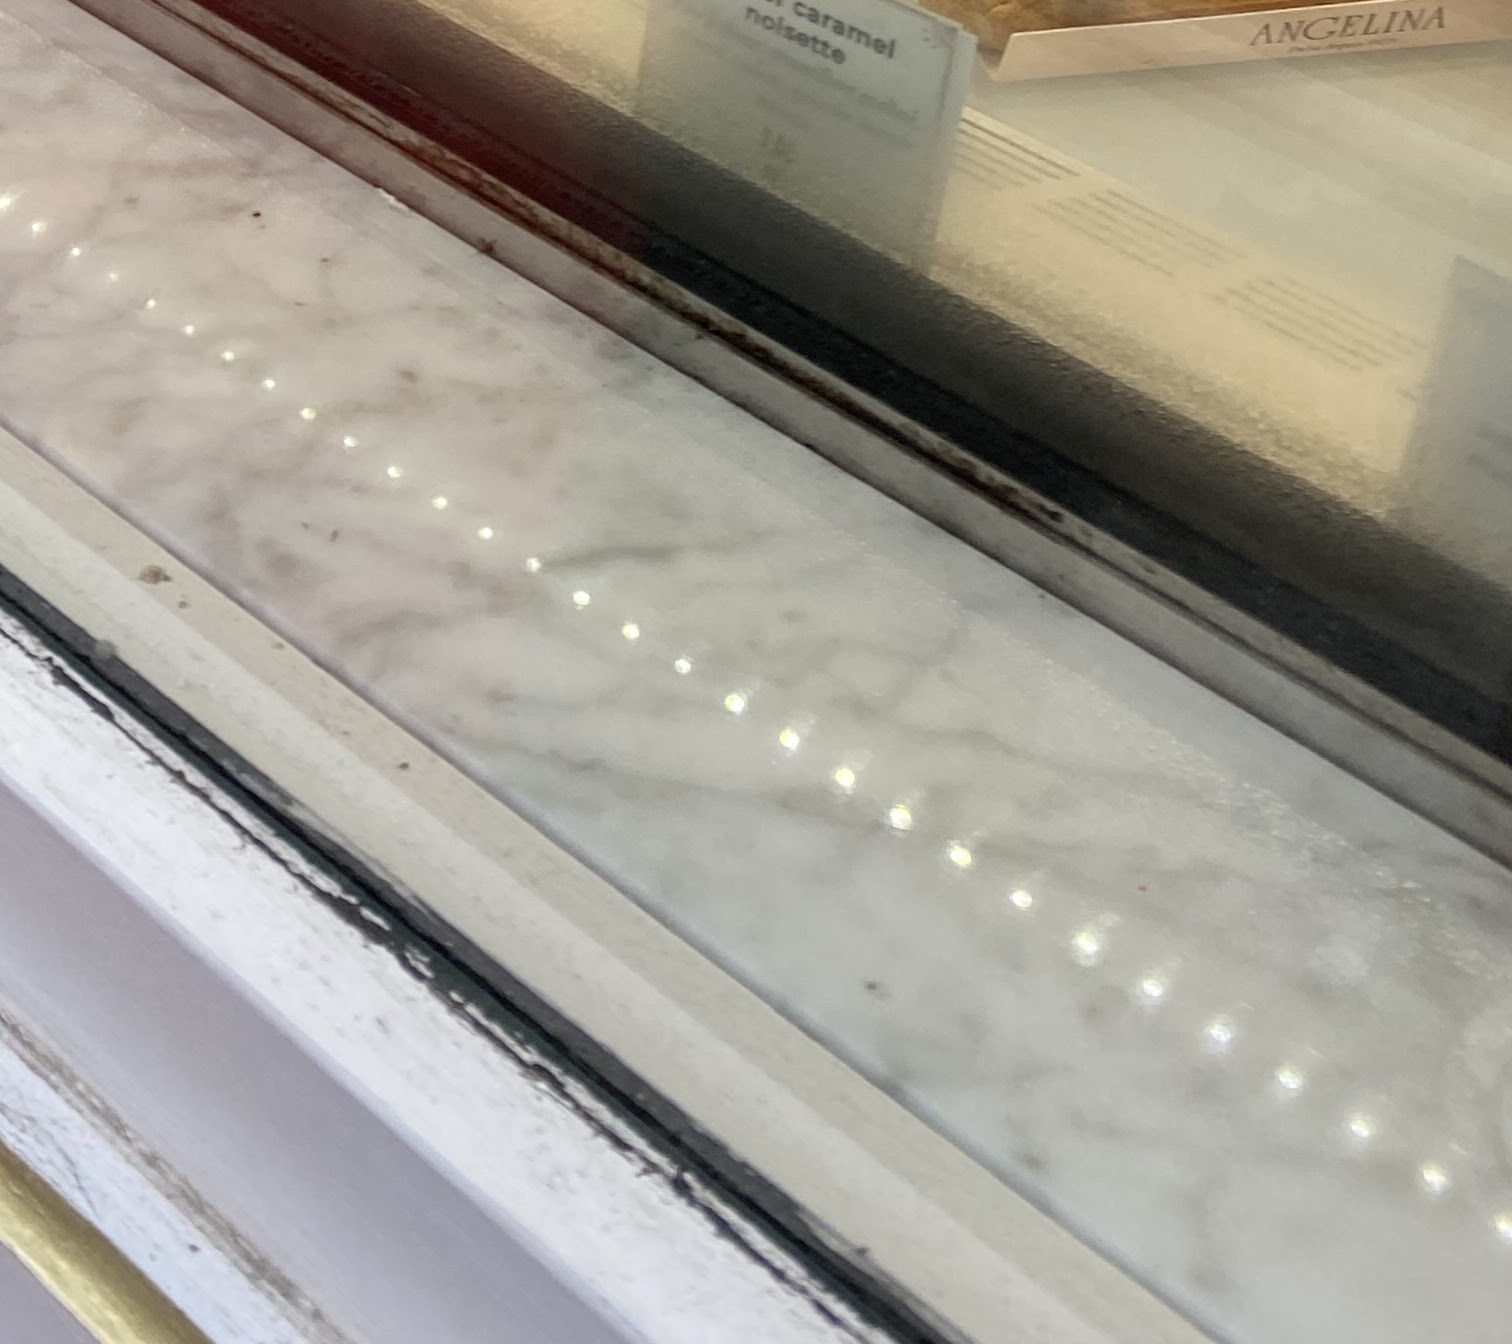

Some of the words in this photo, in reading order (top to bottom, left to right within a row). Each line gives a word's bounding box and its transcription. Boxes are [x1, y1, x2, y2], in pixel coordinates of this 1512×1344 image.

[745, 6, 847, 65] noisette
[792, 1, 897, 59] caramel
[1248, 6, 1447, 47] ANGELINA
